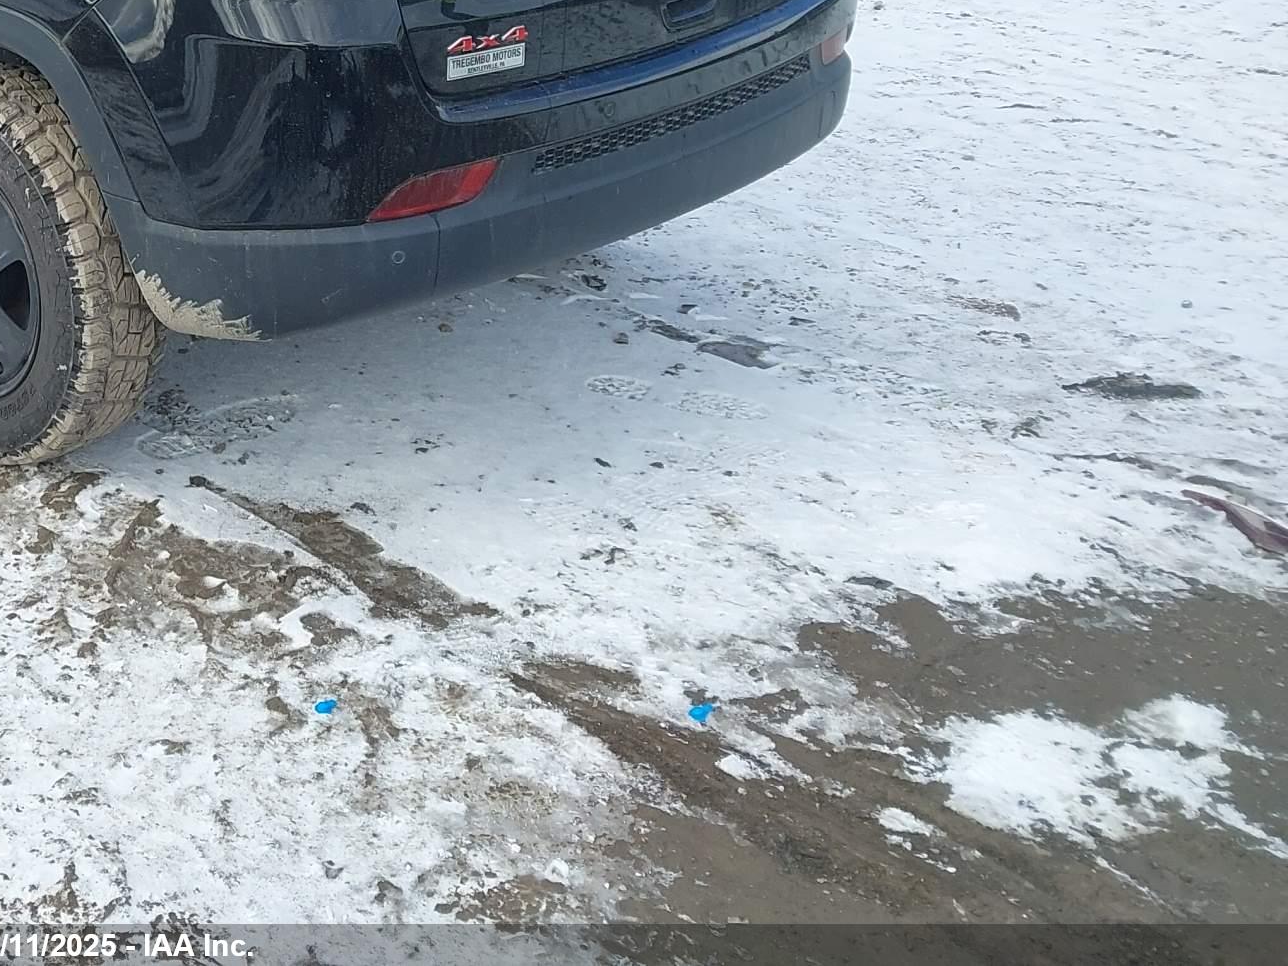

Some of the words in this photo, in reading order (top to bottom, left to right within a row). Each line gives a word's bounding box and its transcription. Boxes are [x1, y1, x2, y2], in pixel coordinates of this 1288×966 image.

[447, 25, 529, 54] 4x4
[452, 54, 491, 69] TREGEMBO
[492, 48, 522, 63] MOTORS
